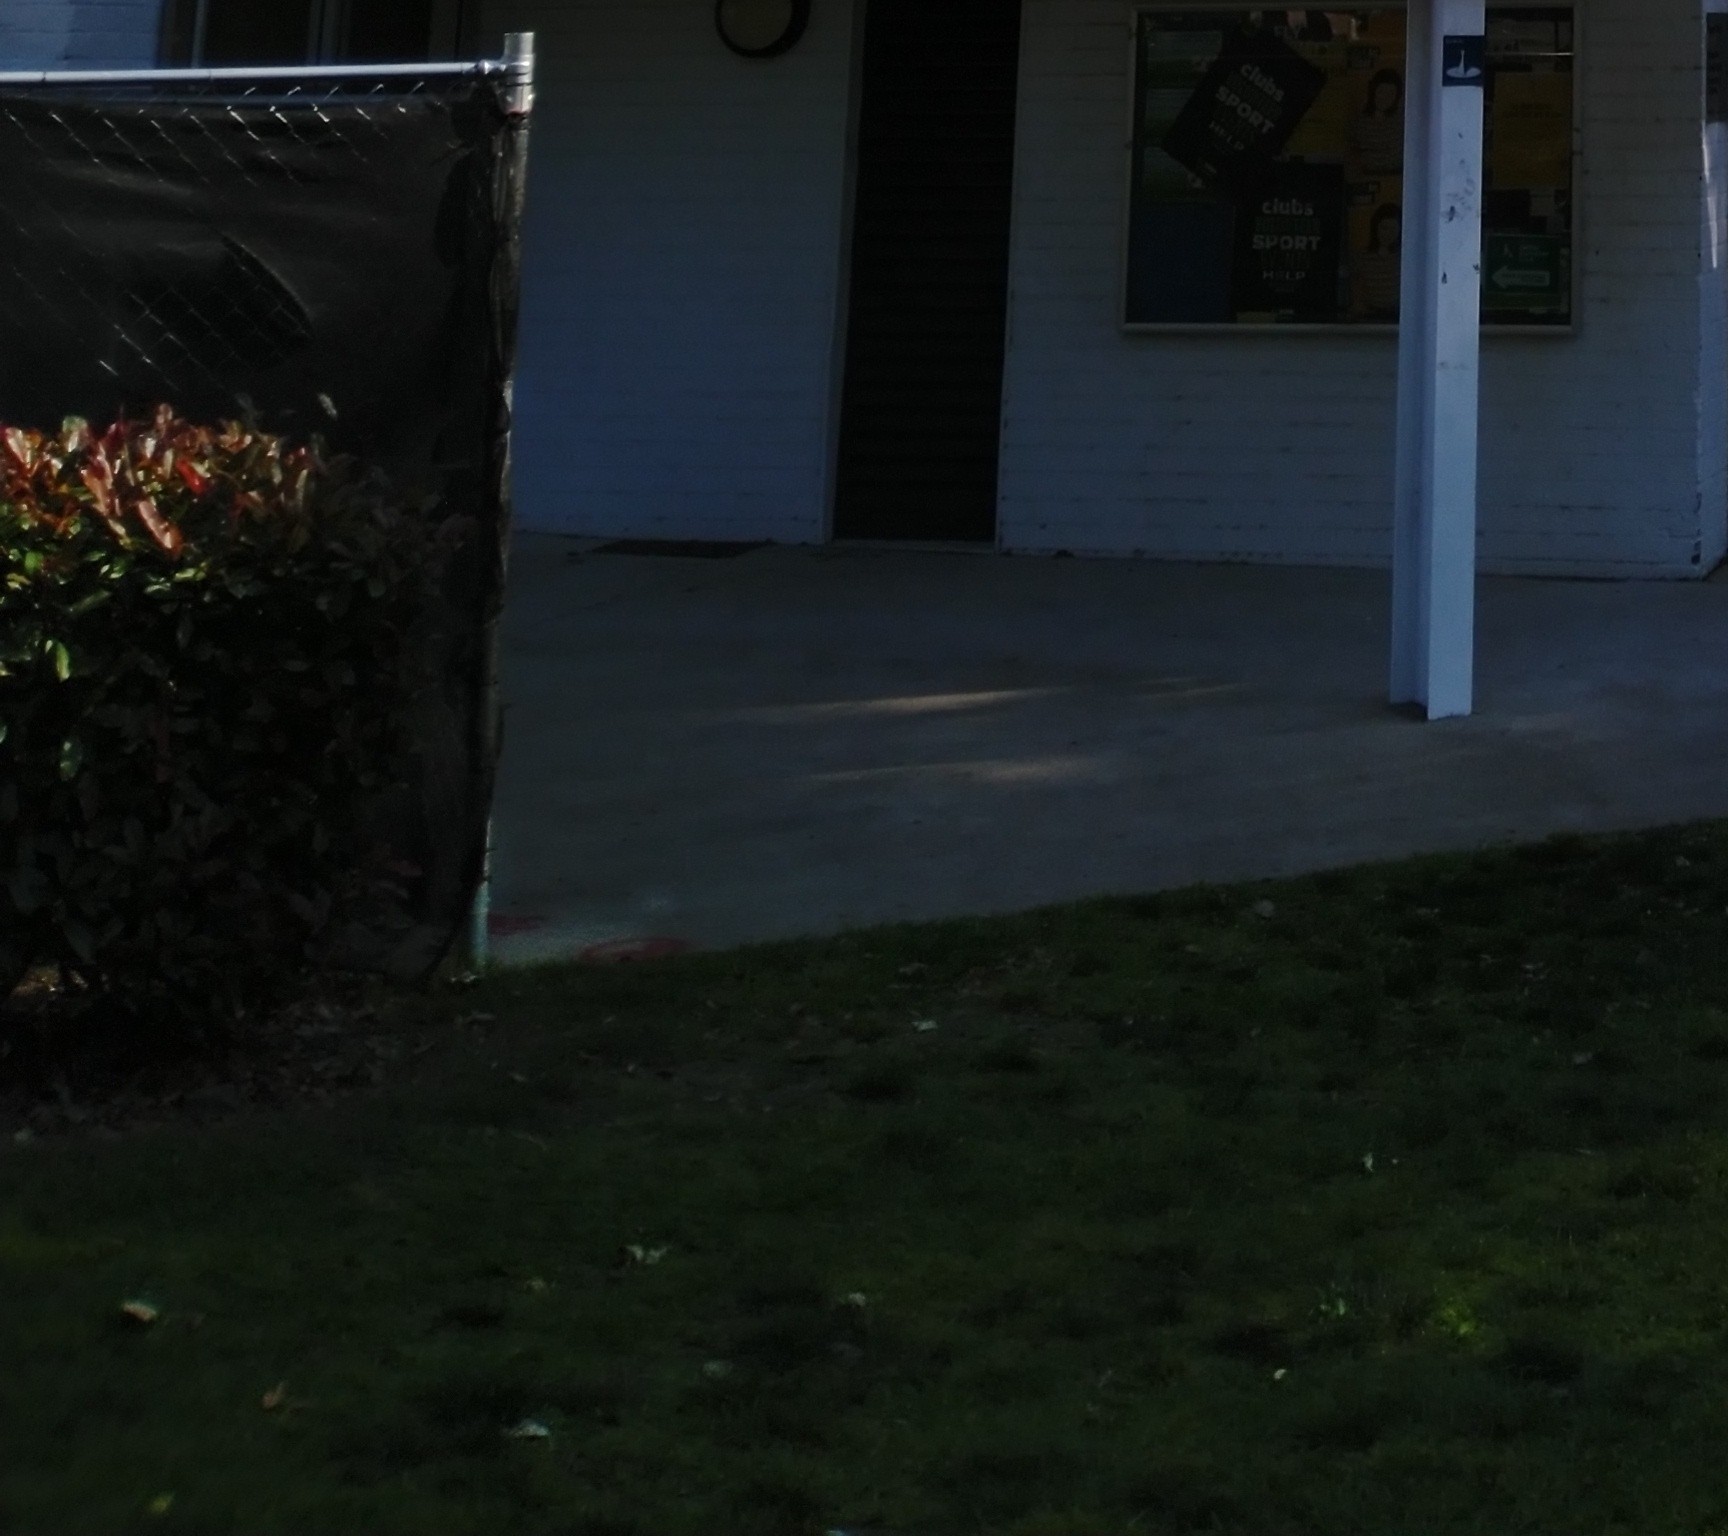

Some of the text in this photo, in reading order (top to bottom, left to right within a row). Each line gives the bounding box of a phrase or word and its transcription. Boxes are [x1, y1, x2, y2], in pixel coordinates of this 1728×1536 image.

[1240, 64, 1285, 102] clubs
[1215, 85, 1275, 134] SPORT
[1261, 198, 1314, 216] clubs
[1252, 234, 1322, 251] SPORT
